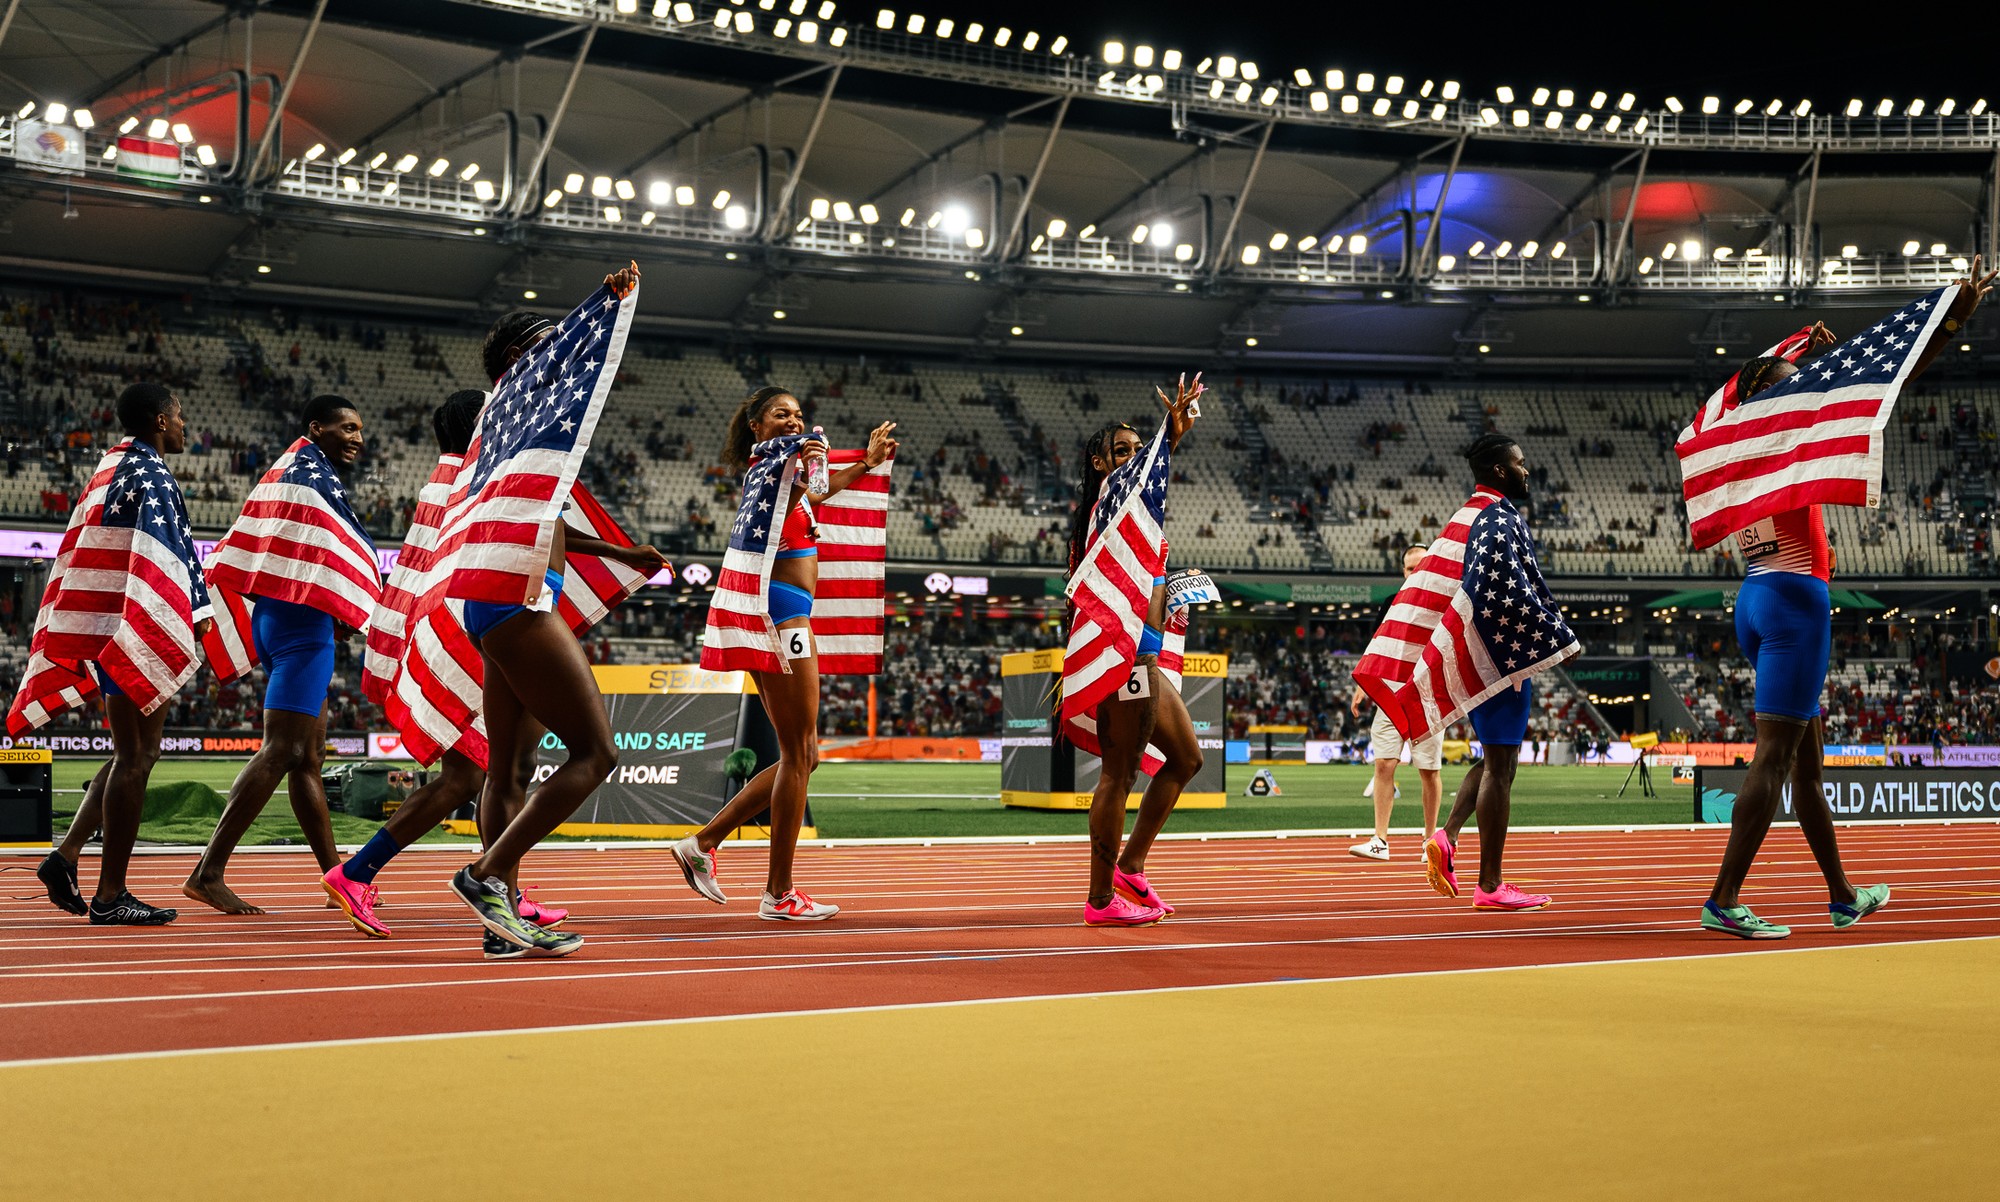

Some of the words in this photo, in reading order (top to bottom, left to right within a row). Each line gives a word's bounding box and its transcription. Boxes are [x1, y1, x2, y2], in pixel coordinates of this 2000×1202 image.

[1739, 527, 1760, 547] USA
[1166, 575, 1212, 601] RICHARDS
[1166, 589, 1209, 614] NTN
[790, 632, 804, 655] 6
[1183, 658, 1221, 674] EIKO
[1569, 670, 1624, 681] UDAPEST
[203, 737, 263, 751] BUDAPE
[614, 732, 652, 750] AND
[655, 732, 706, 750] SAFE
[0, 752, 41, 762] SEIKO
[1841, 746, 1867, 756] NTN
[619, 765, 680, 784] HOME
[1781, 781, 1865, 814] WRLD
[1870, 781, 1985, 813] ATHLETICS
